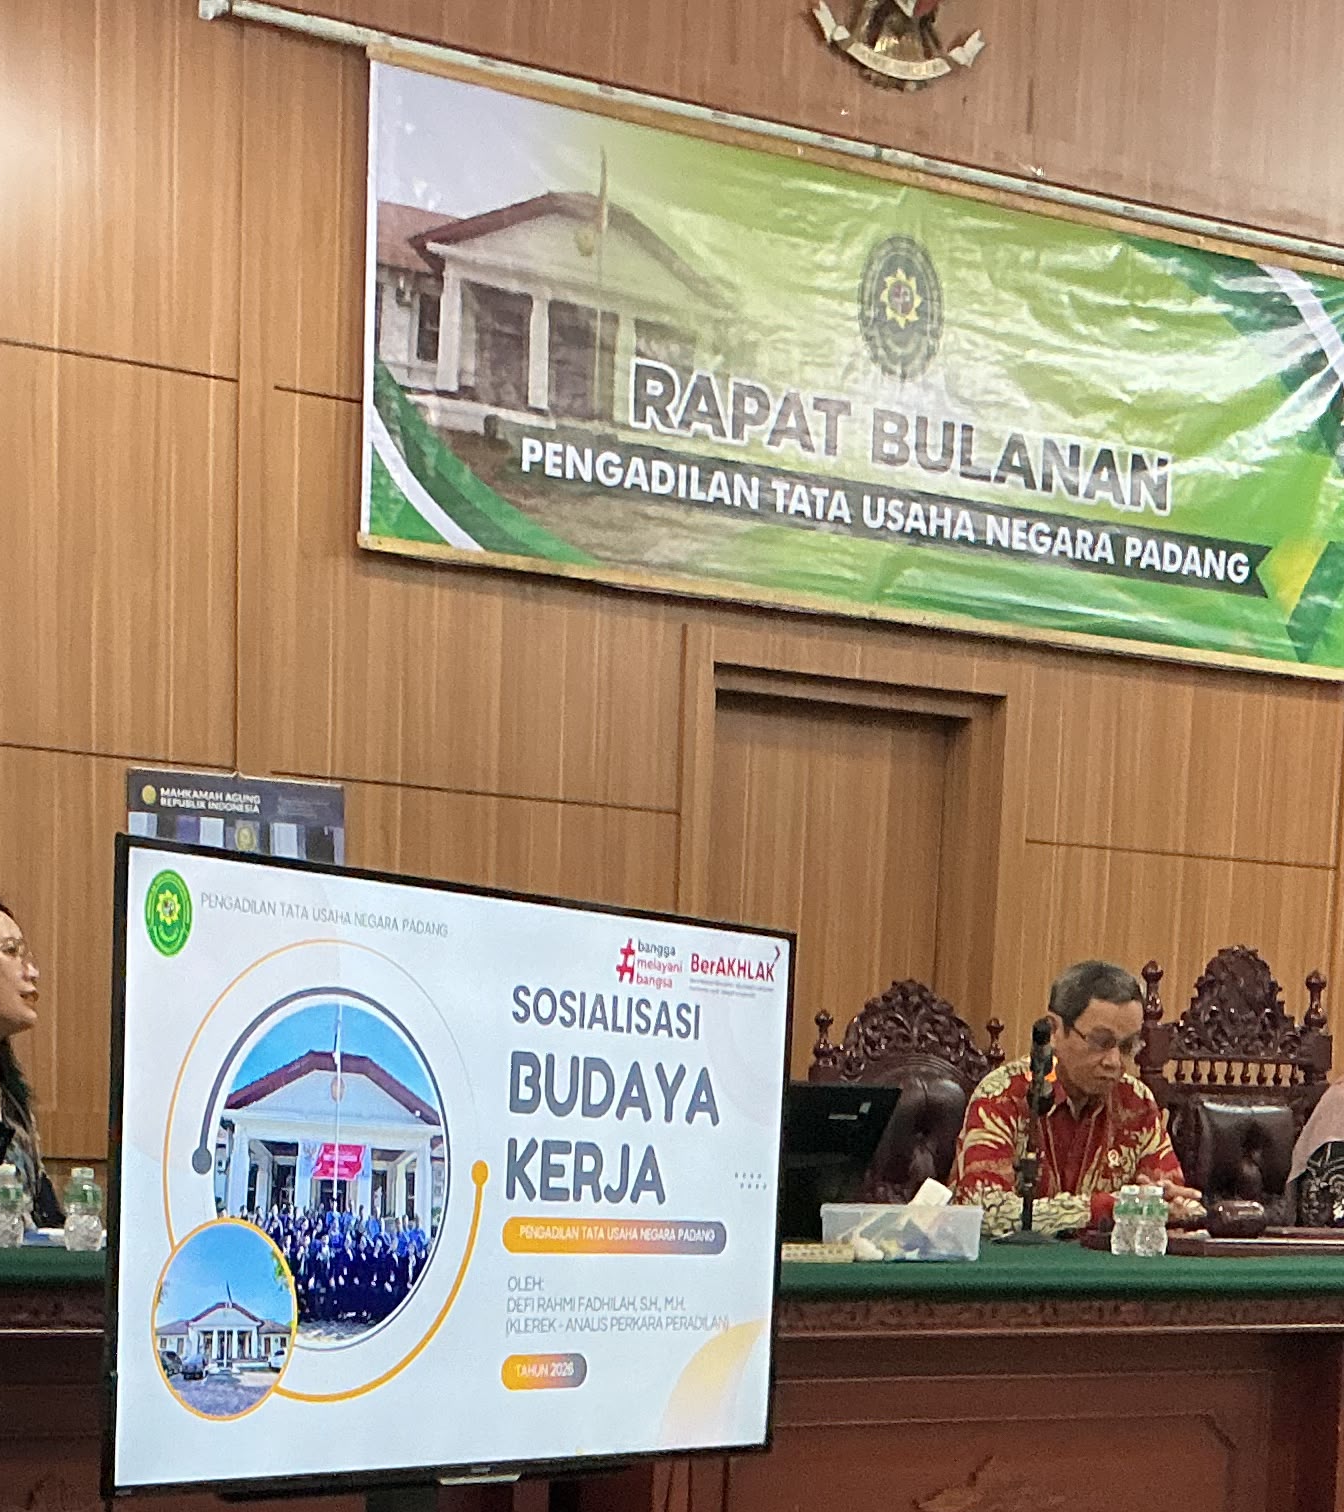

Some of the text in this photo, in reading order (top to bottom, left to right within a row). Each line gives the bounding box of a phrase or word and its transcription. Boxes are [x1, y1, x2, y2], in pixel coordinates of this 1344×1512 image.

[629, 359, 1172, 516] RAPAT BULANAN
[520, 439, 1250, 584] PENGADILAN TATA USAHA NEGARA PADANG
[160, 787, 261, 804] MAHKAMAH AGUNG
[160, 798, 260, 814] REPUBLIK INDONESIA
[201, 892, 448, 938] PENGADILAN TATA USAHA NEGARA PADANG
[638, 939, 676, 958] bangga
[637, 958, 683, 974] melayani
[691, 950, 775, 983] BerAKHLAK
[636, 974, 673, 990] bangsa
[512, 985, 701, 1040] SOSIALISASI
[509, 1050, 720, 1127] BUDAYA
[506, 1137, 666, 1205] KERJA
[519, 1224, 716, 1242] PENGADILAN TATA USAHA NEGARA PADANG
[507, 1275, 544, 1292] OLEH:
[507, 1297, 535, 1313] DEFI
[538, 1297, 576, 1313] RAHMI
[610, 1316, 664, 1332] PERKARA
[516, 1363, 549, 1378] TAHUN
